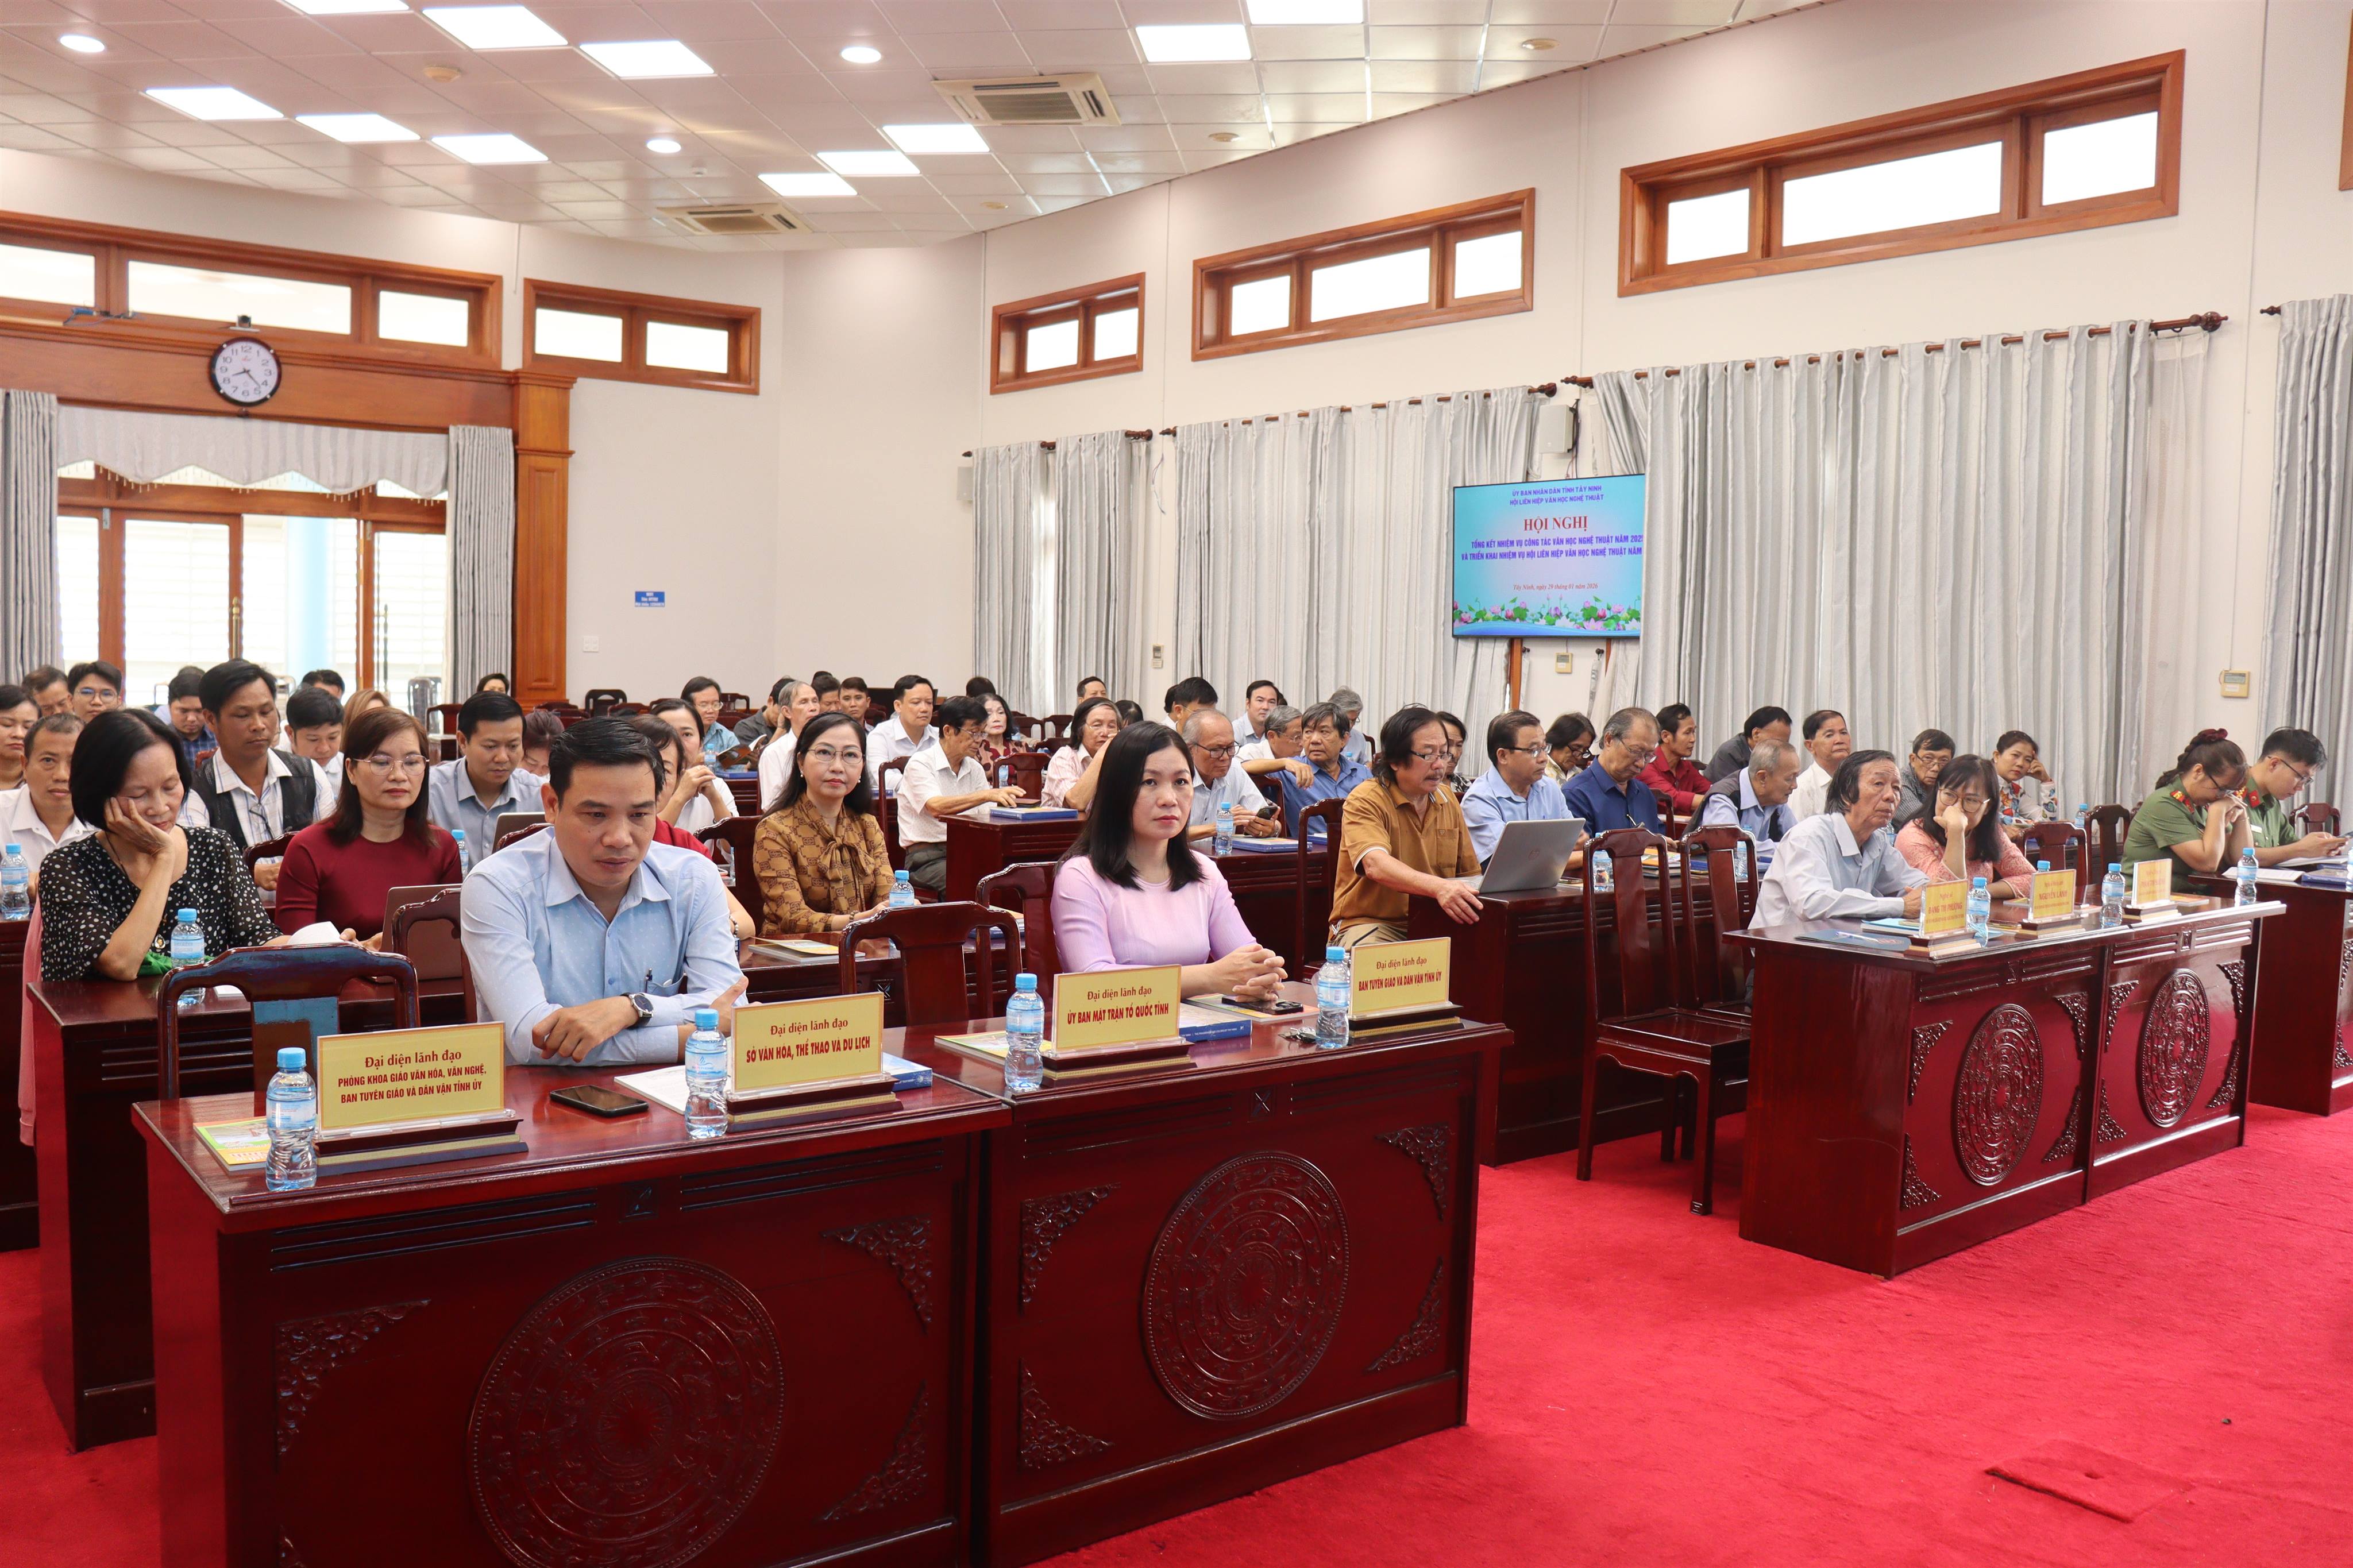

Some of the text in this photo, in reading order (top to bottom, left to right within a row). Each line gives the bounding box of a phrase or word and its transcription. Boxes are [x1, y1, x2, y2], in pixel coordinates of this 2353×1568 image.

[1523, 516, 1588, 533] HỘI NGHỊ
[1472, 538, 1484, 549] TỔNG
[1486, 539, 1495, 548] KẾT
[1497, 539, 1514, 549] NHIỆM
[1516, 540, 1522, 548] VỤ
[1524, 538, 1539, 546] CÔNG
[1541, 536, 1551, 546] TÁC
[1553, 536, 1564, 546] VĂN
[1566, 538, 1576, 546] HỌC
[1579, 535, 1594, 546] NGHỆ
[1596, 534, 1613, 545] THUẬT
[1615, 534, 1628, 543] NĂM
[1461, 553, 1468, 561] VÀ
[1469, 550, 1484, 561] TRIỂN
[1499, 550, 1516, 561] NHIỆM
[1518, 551, 1525, 559] VỤ
[1526, 549, 1535, 560] HỘI
[1537, 549, 1549, 558] LIÊN
[1551, 549, 1564, 559] HIỆP
[1565, 548, 1576, 557] VĂN
[1578, 549, 1589, 558] HỌC
[1591, 547, 1606, 557] NGHỆ
[1608, 547, 1626, 557] THUẬT
[1628, 546, 1642, 555] NĂM
[1376, 956, 1427, 971] Đại diện lãnh đạo
[1359, 969, 1442, 991] BAN TUYÊN GIÁO VÀ DÂN VẬN TỈNH ỦY
[1087, 986, 1151, 1002] Đại diện lãnh đạo
[1067, 1001, 1168, 1025] ỦY BAN MẶT TRẬN TỔ QUỐC TỈNH
[770, 1018, 848, 1037] Đại diện lãnh đạo
[747, 1036, 870, 1063] SỞ VĂN HÓA, THỂ THAO VÀ DU LỊCH
[365, 1049, 461, 1071] Đại diện lãnh đạo
[338, 1063, 487, 1087] PHÒNG KHOA GIÁO VĂN HÓA, VĂN NGHỆ,
[341, 1078, 483, 1104] BAN TUYÊN GIÁO VÀ DÂN VẬN TỈNH ỦY
